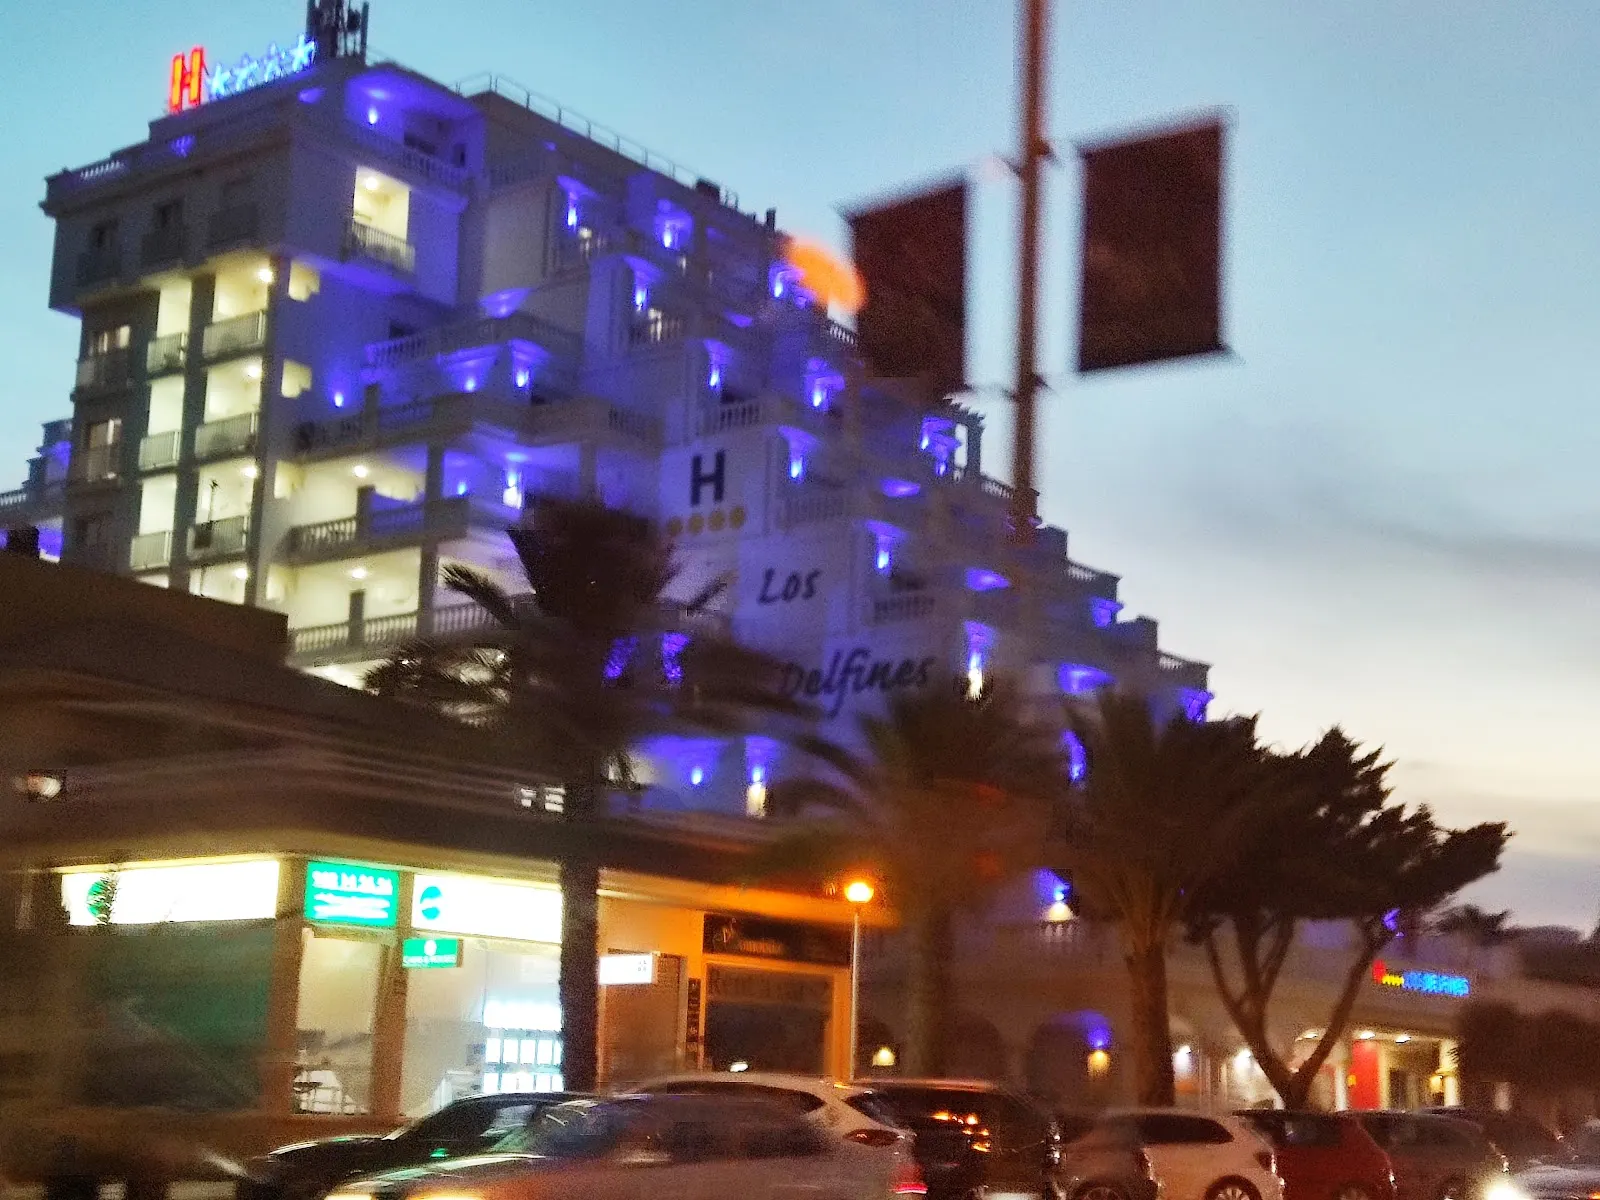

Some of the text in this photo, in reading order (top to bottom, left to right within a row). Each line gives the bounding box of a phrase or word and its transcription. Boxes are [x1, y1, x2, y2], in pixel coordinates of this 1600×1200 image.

[168, 46, 205, 115] H
[690, 450, 725, 505] H
[757, 567, 820, 604] Los
[780, 649, 936, 718] Delfines
